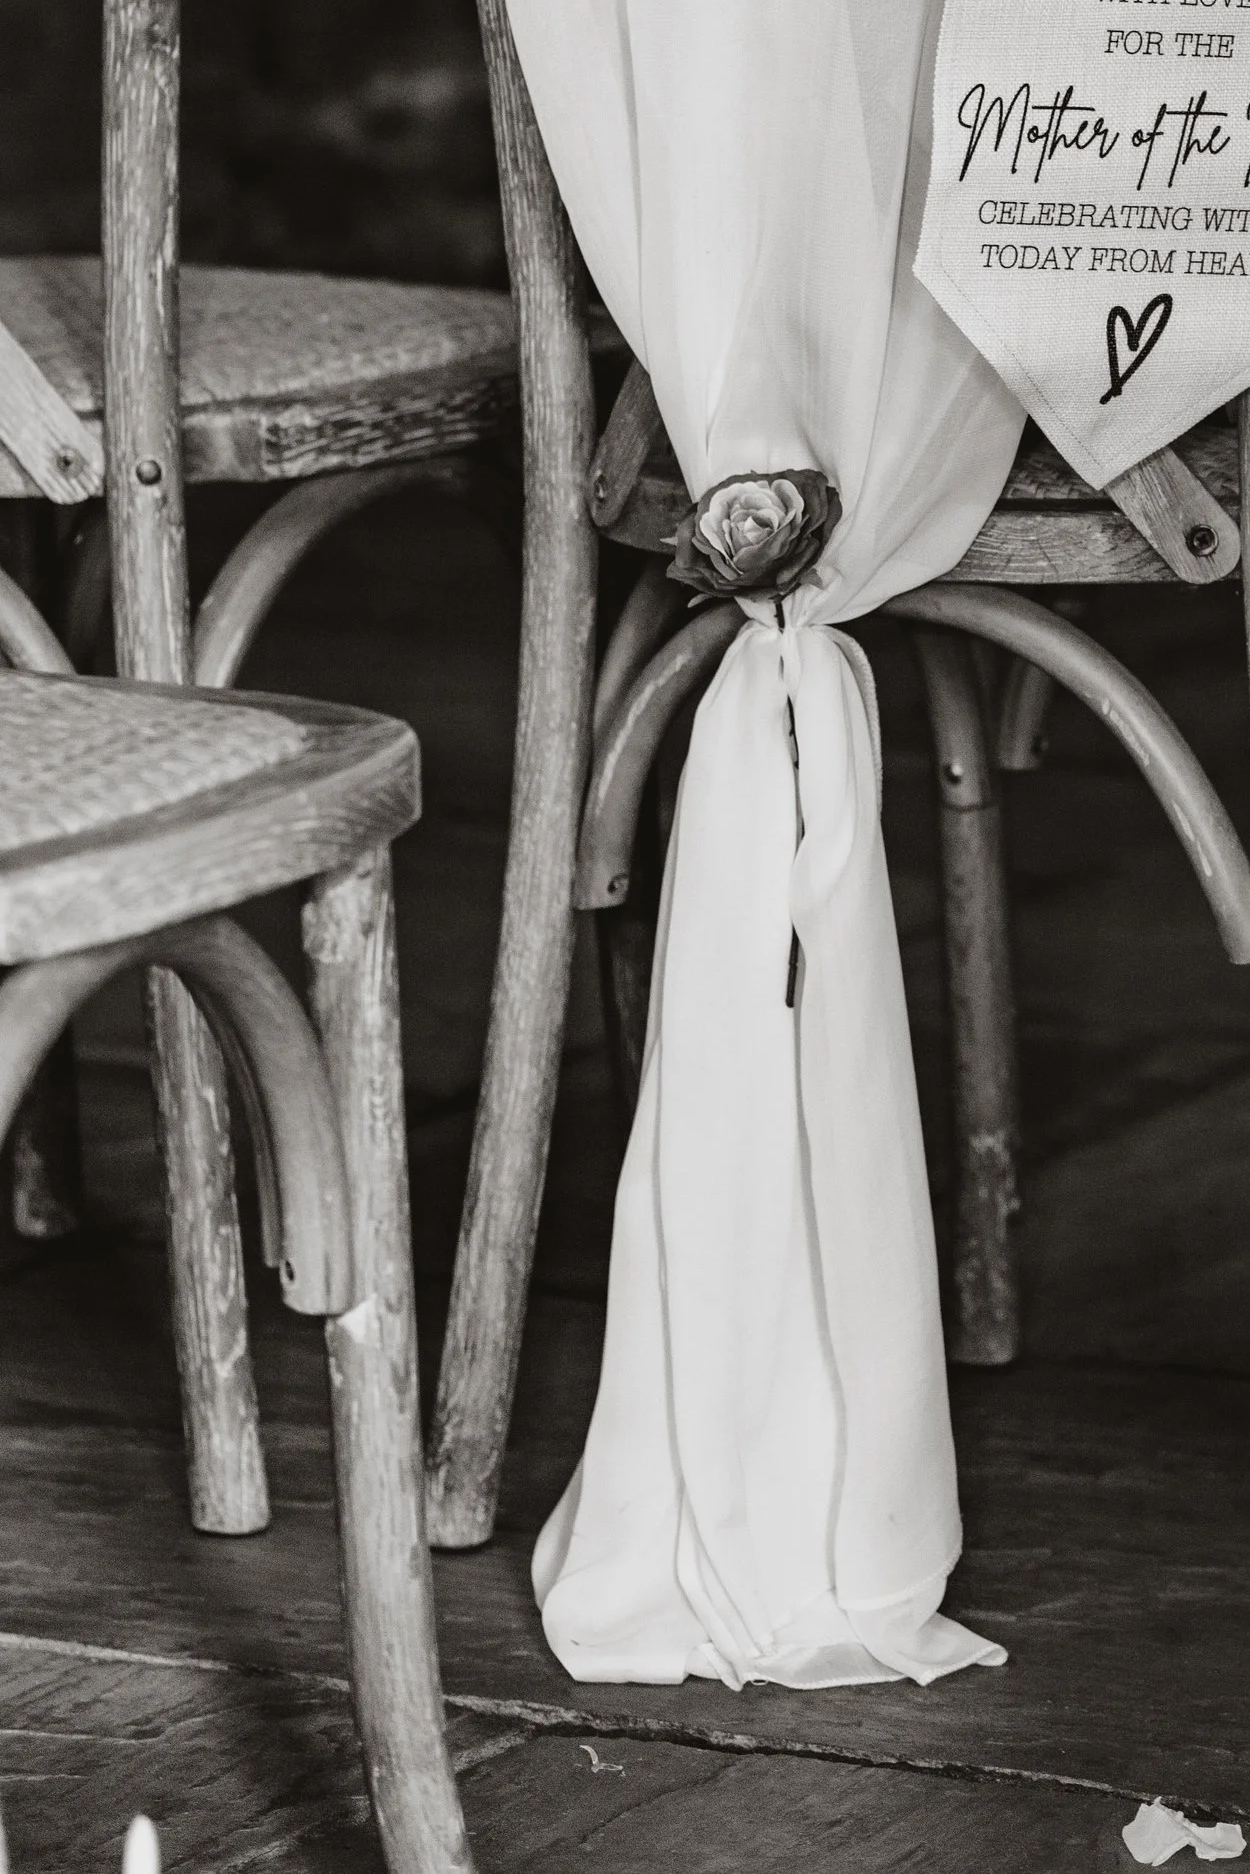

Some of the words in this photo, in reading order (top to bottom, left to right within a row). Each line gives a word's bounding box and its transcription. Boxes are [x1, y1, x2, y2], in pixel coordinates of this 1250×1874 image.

[1104, 30, 1164, 55] FOR
[1175, 33, 1235, 58] THE
[958, 83, 1120, 184] Mother
[1131, 103, 1165, 191] of
[1165, 90, 1231, 188] the
[978, 200, 1193, 230] CELEBRATING
[981, 244, 1082, 270] TODAY
[1088, 248, 1177, 273] FROM
